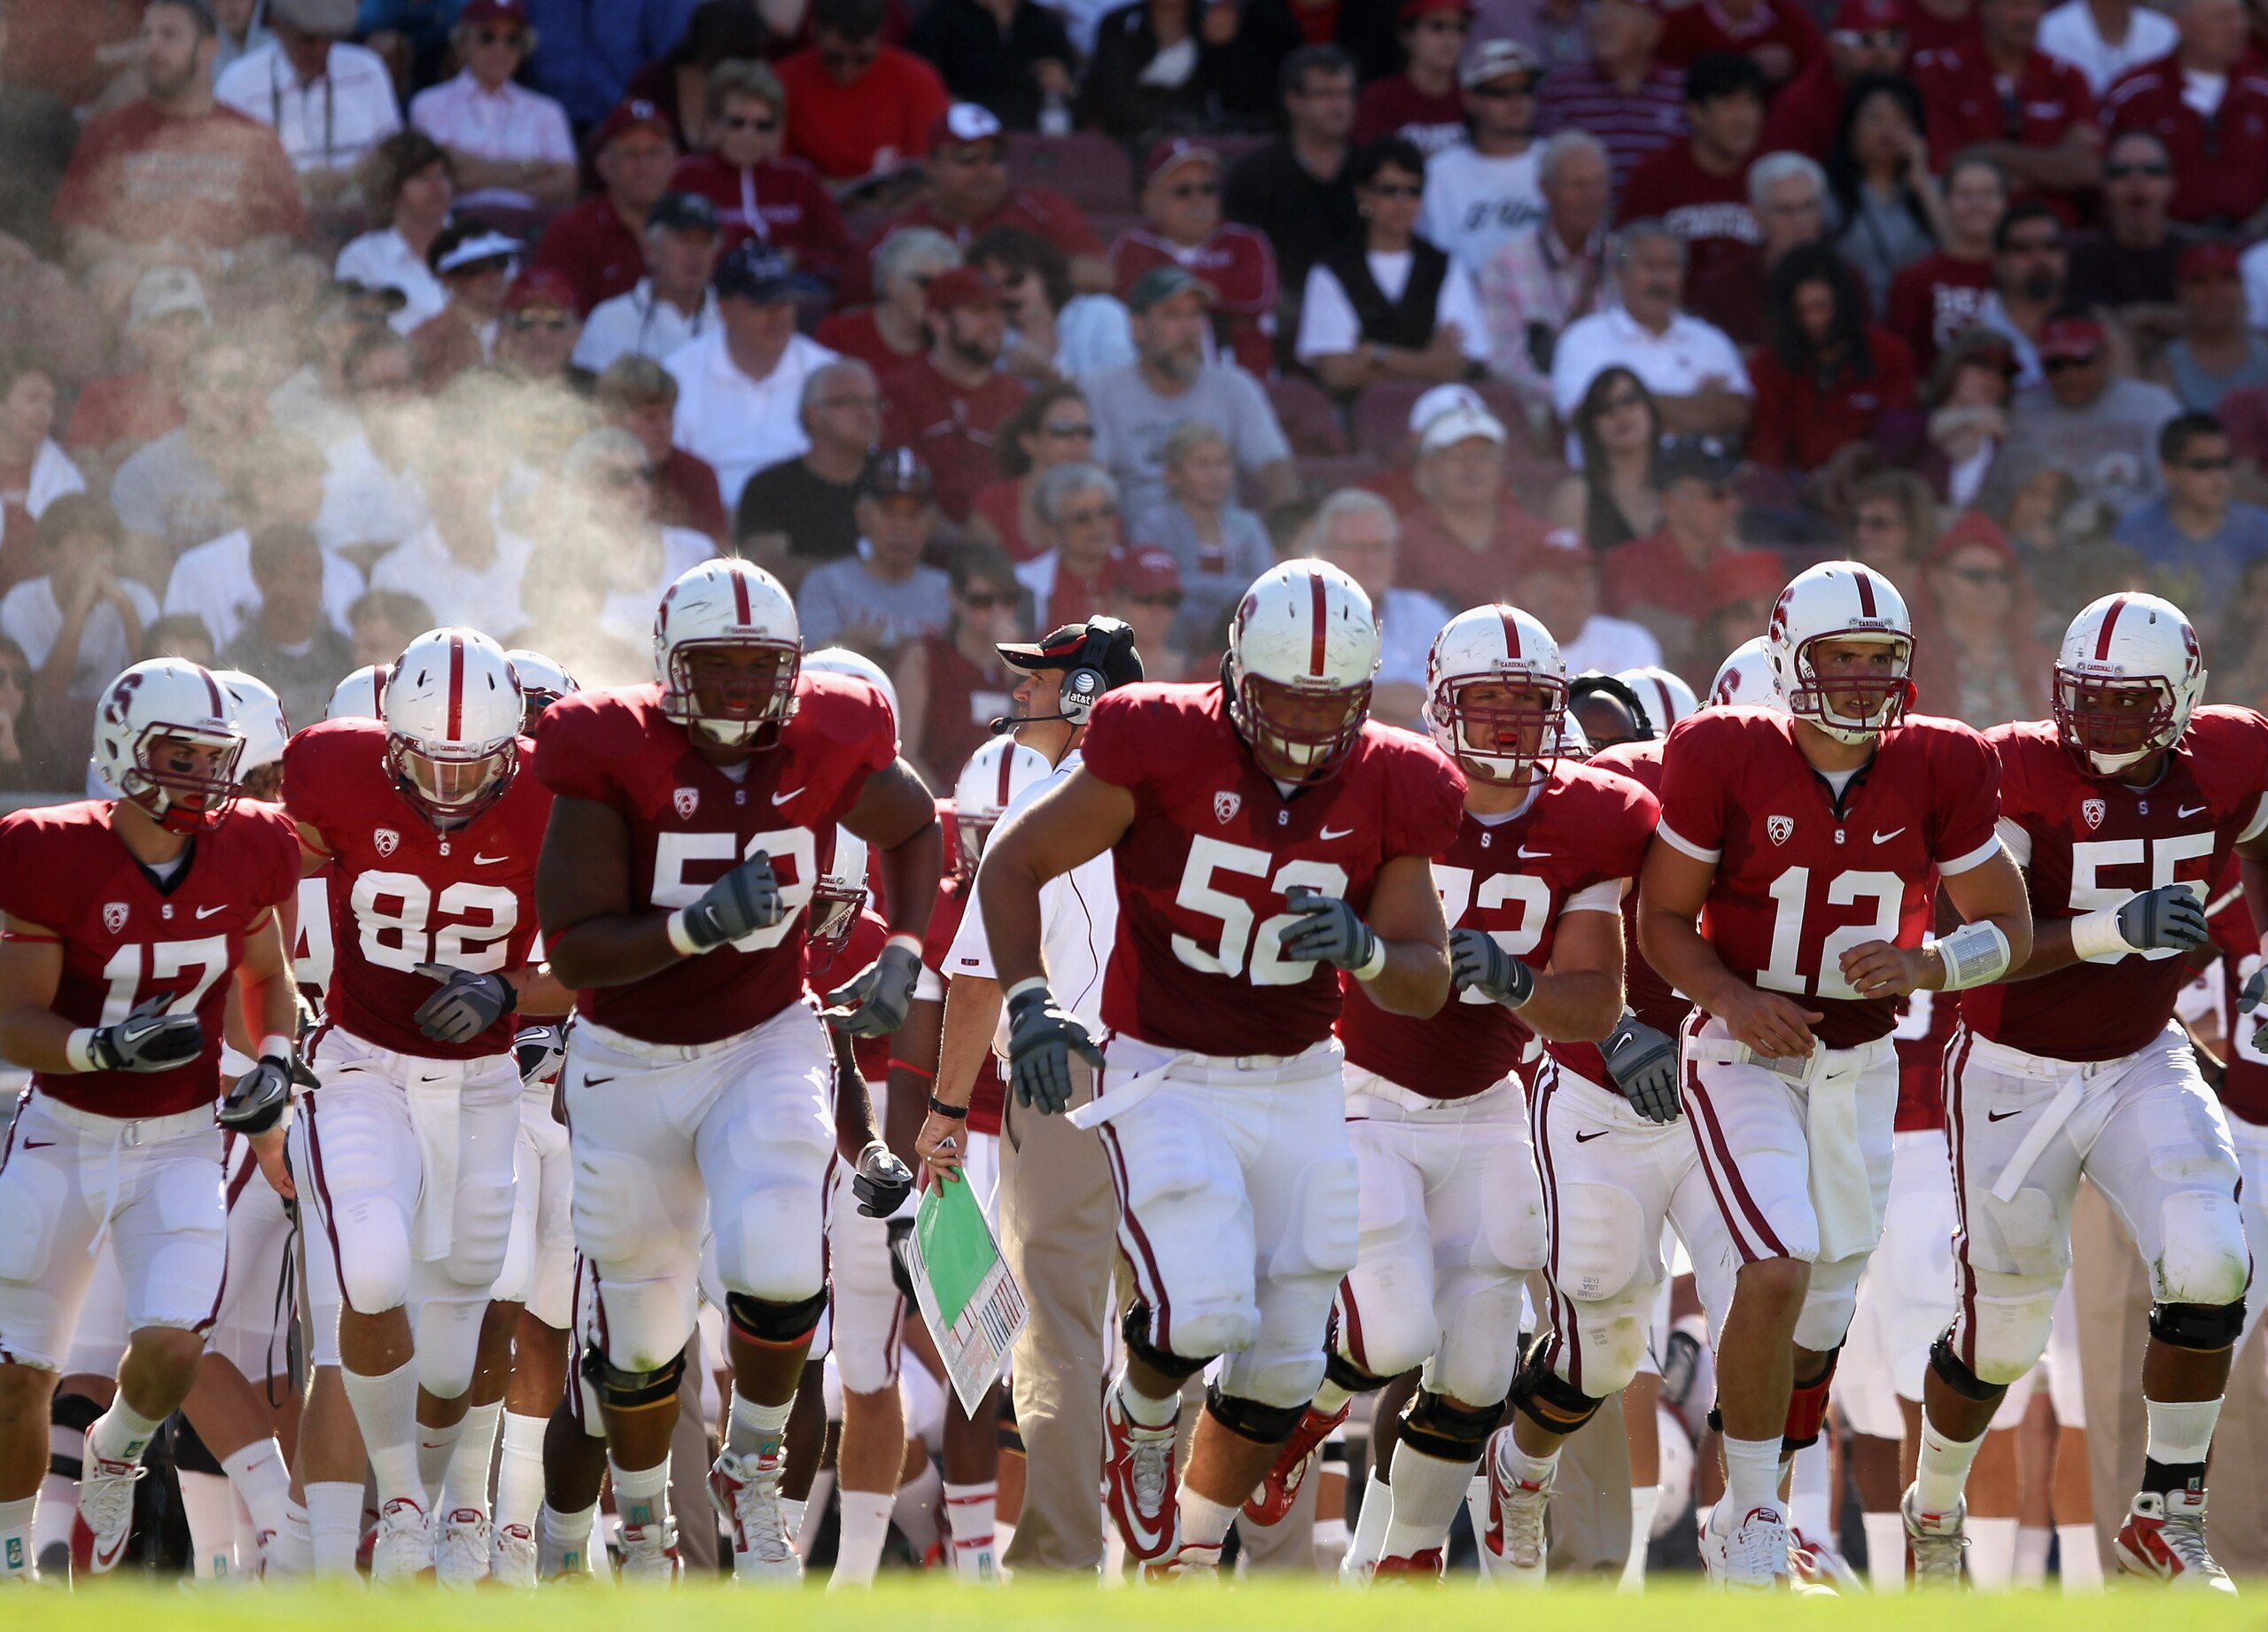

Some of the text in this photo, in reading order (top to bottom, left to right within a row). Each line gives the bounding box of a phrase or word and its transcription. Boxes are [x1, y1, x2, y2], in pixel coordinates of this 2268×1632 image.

[105, 673, 144, 724] S
[1070, 692, 1091, 705] at&t
[734, 789, 746, 804] S
[2085, 801, 2105, 817] PAC
[2138, 801, 2148, 815] S
[1278, 810, 1290, 826] S
[2089, 812, 2101, 823] 10
[1769, 817, 1792, 835] PAC
[376, 829, 397, 847] PAC
[1480, 832, 1492, 848] S
[1773, 828, 1786, 841] 10
[1834, 828, 1845, 844] S
[379, 841, 392, 852] 10
[439, 843, 450, 857] S
[2068, 830, 2216, 965] 55
[161, 904, 174, 920] S
[1170, 833, 1349, 986] 52
[350, 868, 518, 975] 82
[825, 909, 850, 931] Riddell
[1756, 865, 1906, 1000] 12
[99, 934, 229, 1029] 17
[1577, 1289, 1604, 1299] ADAMS
